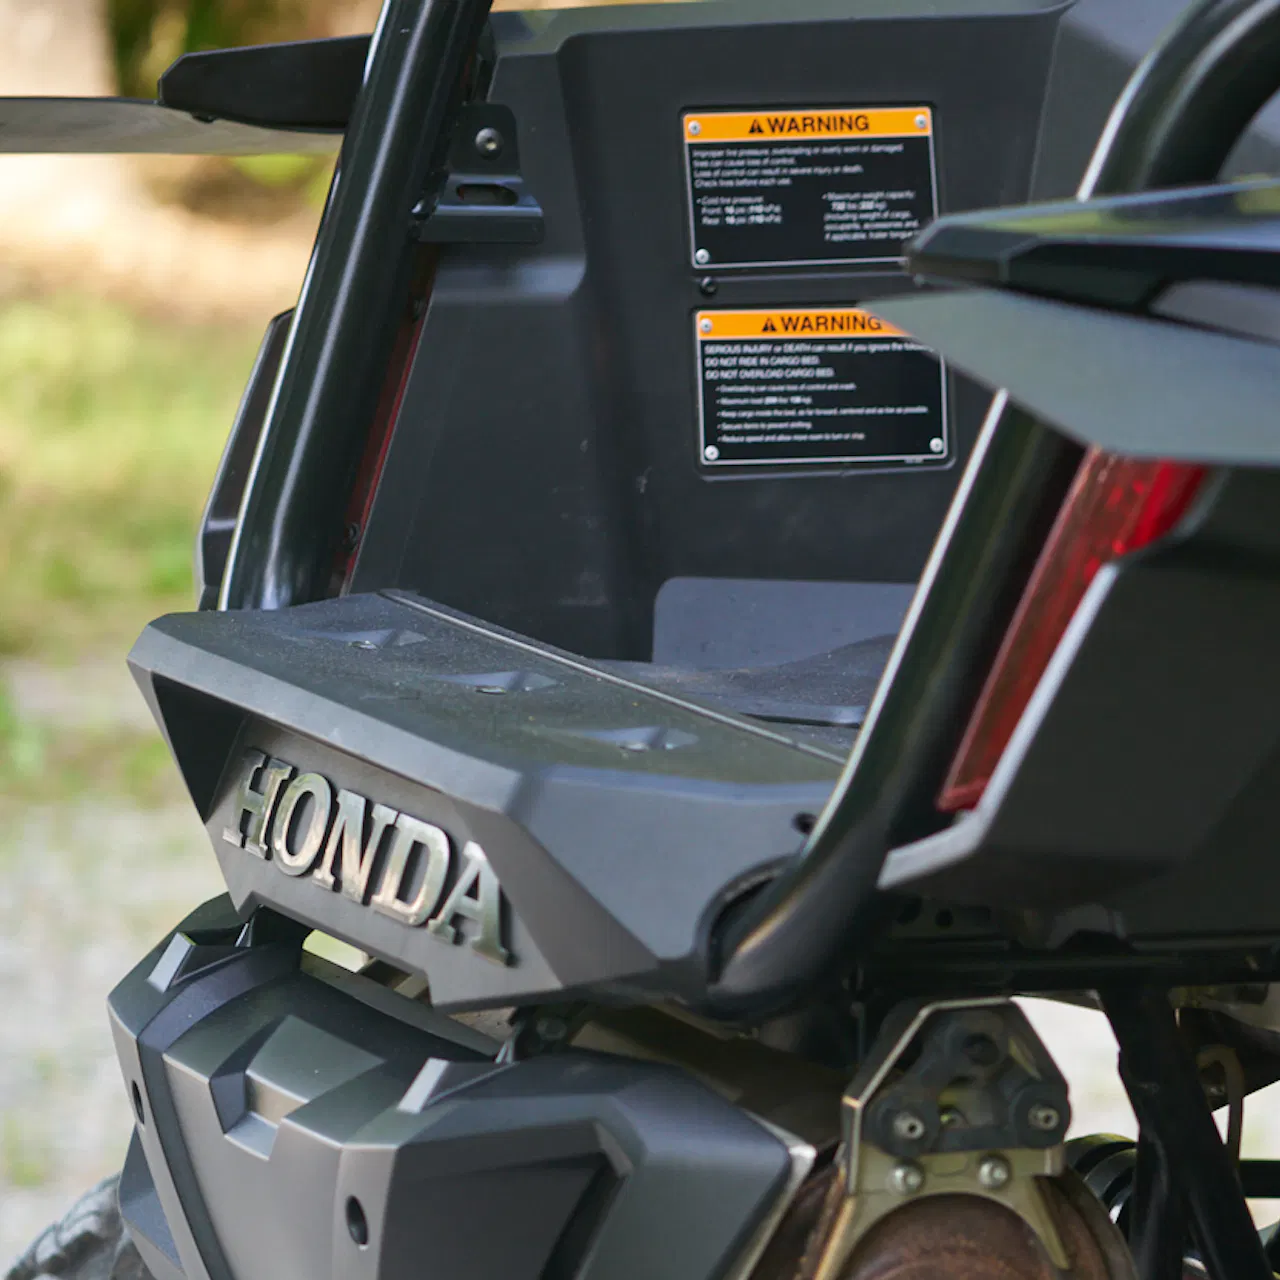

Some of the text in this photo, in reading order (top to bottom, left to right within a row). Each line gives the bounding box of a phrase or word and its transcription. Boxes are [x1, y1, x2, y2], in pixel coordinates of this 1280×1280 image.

[766, 114, 869, 134] WARNING
[780, 315, 883, 332] WARNING
[705, 357, 719, 367] DO
[720, 357, 737, 367] NOT
[770, 355, 801, 365] CARGO
[705, 369, 719, 380] DO
[720, 369, 738, 379] NOT
[739, 368, 784, 379] OVERLOAD
[785, 367, 815, 379] CARGO
[222, 748, 510, 967] HONDA
